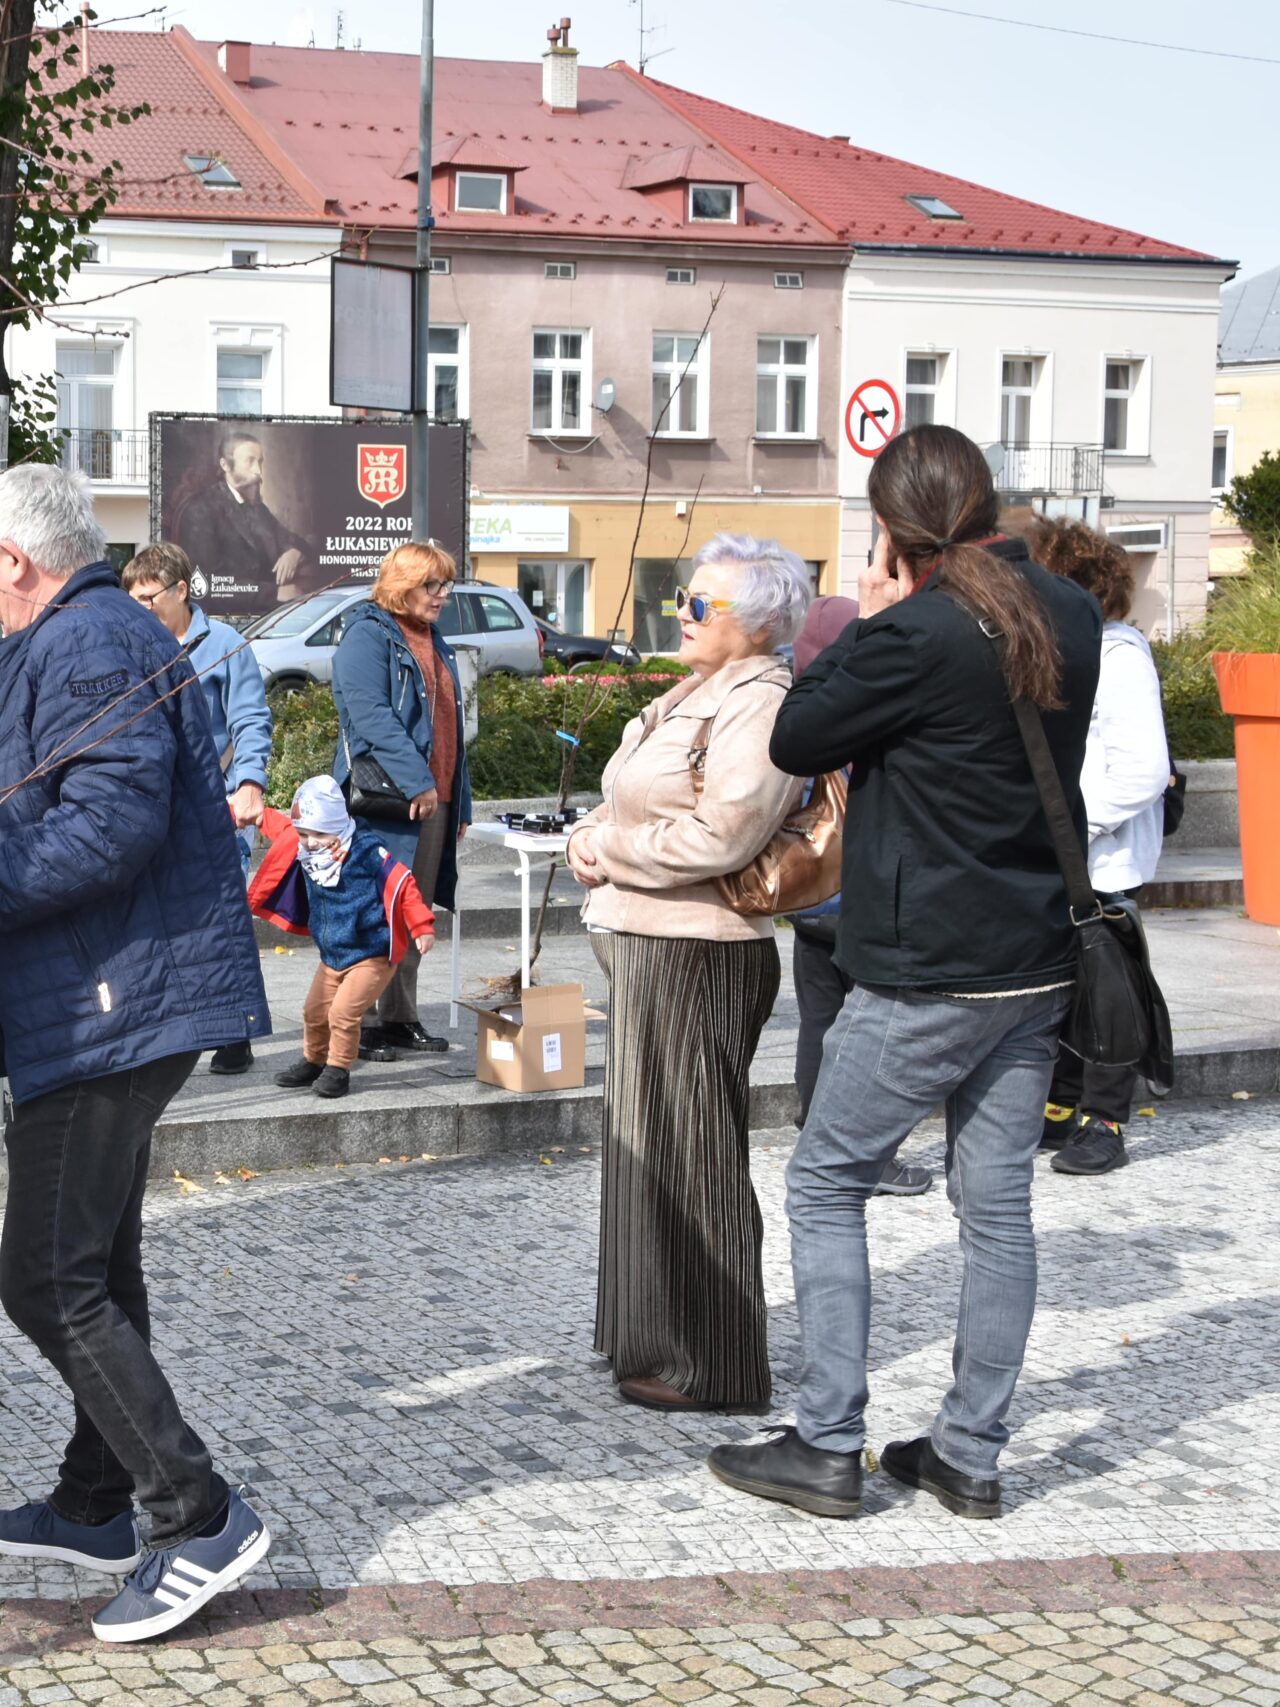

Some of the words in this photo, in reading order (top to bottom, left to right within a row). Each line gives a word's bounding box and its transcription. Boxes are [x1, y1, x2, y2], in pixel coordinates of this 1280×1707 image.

[345, 516, 383, 531] 2022
[210, 573, 235, 585] Ignacy
[210, 582, 259, 593] Łukasiewicz
[238, 1530, 259, 1554] adidas
